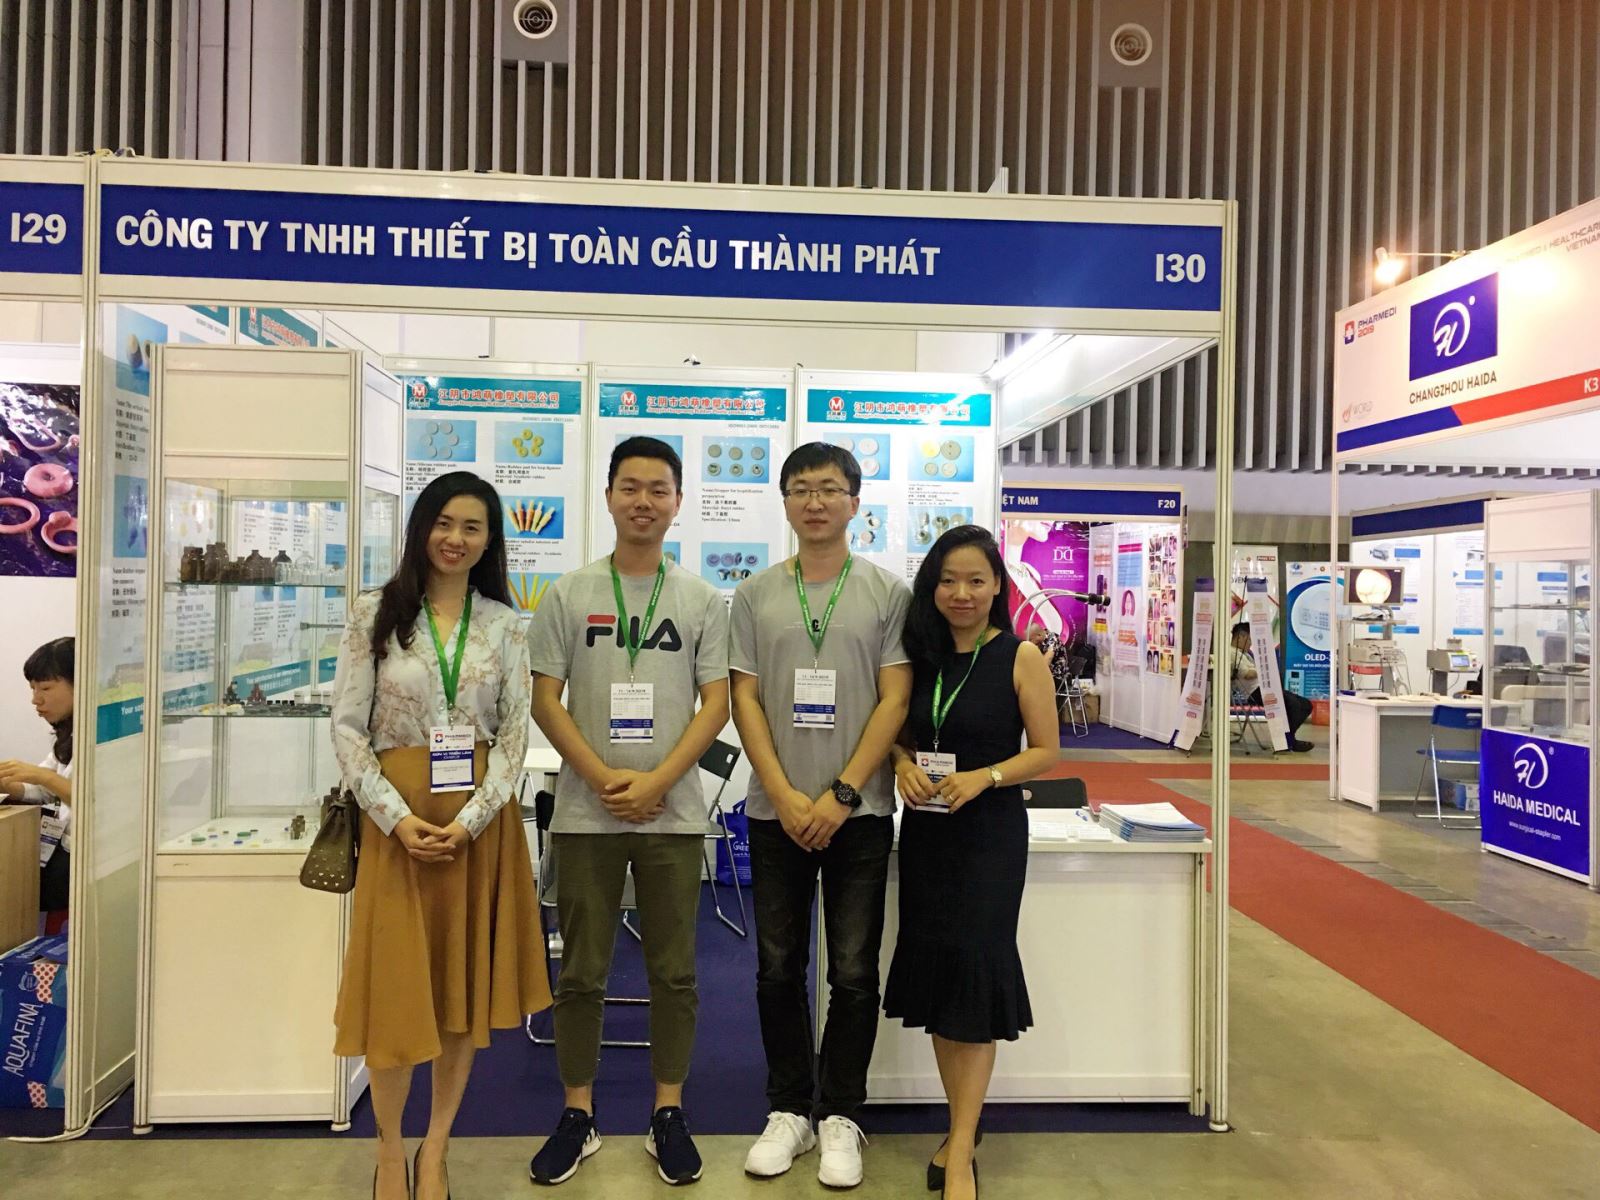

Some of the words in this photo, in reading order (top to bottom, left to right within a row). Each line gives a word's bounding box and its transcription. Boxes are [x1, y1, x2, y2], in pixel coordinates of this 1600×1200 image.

[11, 212, 67, 244] I29
[116, 209, 213, 250] CÔNG
[223, 219, 269, 252] TY
[280, 222, 375, 256] TNHH
[387, 215, 489, 266] THIẾT
[503, 231, 537, 269] BỊ
[548, 226, 639, 267] TOÀN
[651, 224, 718, 270] CẦU
[728, 233, 841, 273] THÀNH
[854, 238, 941, 276] PHÁT
[1549, 221, 1600, 248] HEALTHCAR
[1155, 253, 1206, 283] I30
[1358, 305, 1397, 328] PHARMEDI
[1409, 379, 1464, 405] CHANGZHOU
[1467, 370, 1497, 389] HAIDA
[1002, 494, 1015, 506] ỆT
[1017, 496, 1039, 505] NAM
[1157, 499, 1176, 509] F20
[586, 614, 682, 652] FILA
[1493, 789, 1524, 812] HAIDA
[1525, 798, 1581, 827] MEDICAL
[2, 1002, 44, 1077] AQUAFINA
